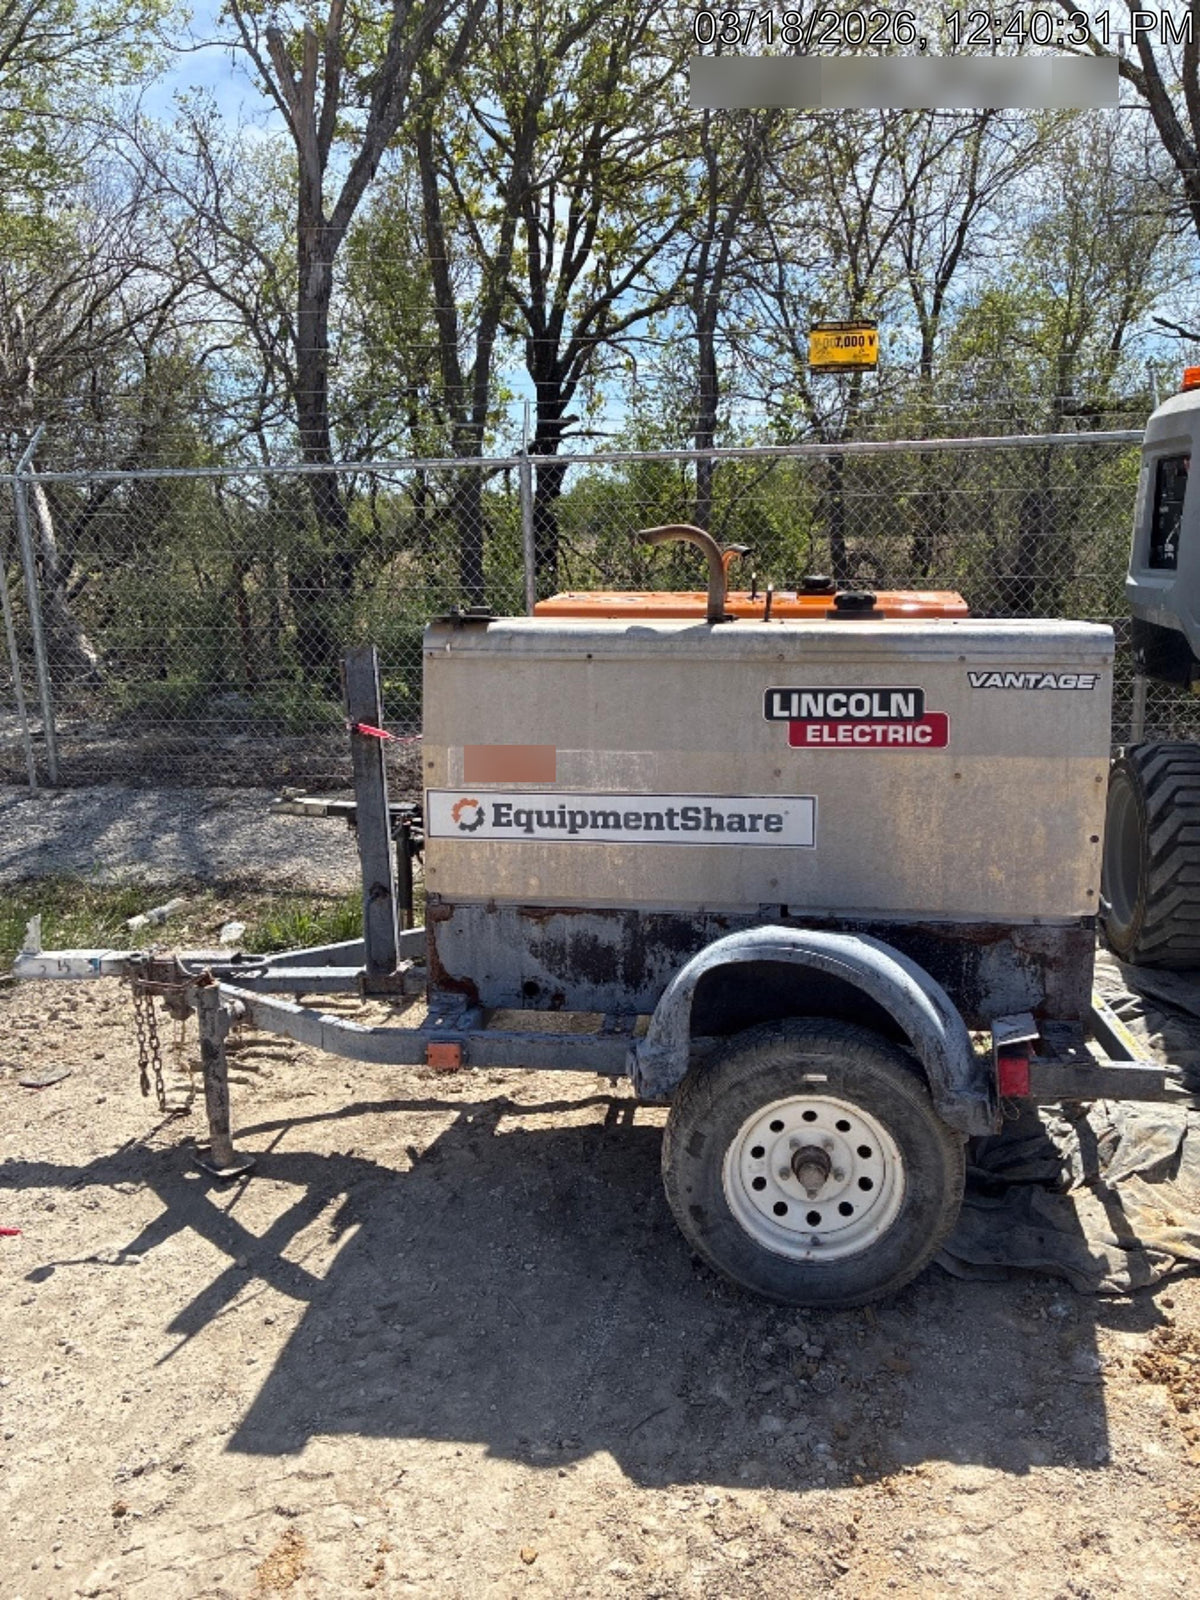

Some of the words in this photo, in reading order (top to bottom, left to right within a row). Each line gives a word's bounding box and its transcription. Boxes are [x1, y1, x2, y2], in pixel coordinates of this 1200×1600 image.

[967, 671, 1096, 690] VANTAGE
[772, 693, 915, 718] LINCOLN
[806, 725, 933, 743] ELECTRIC
[492, 803, 784, 833] EquipmentShare
